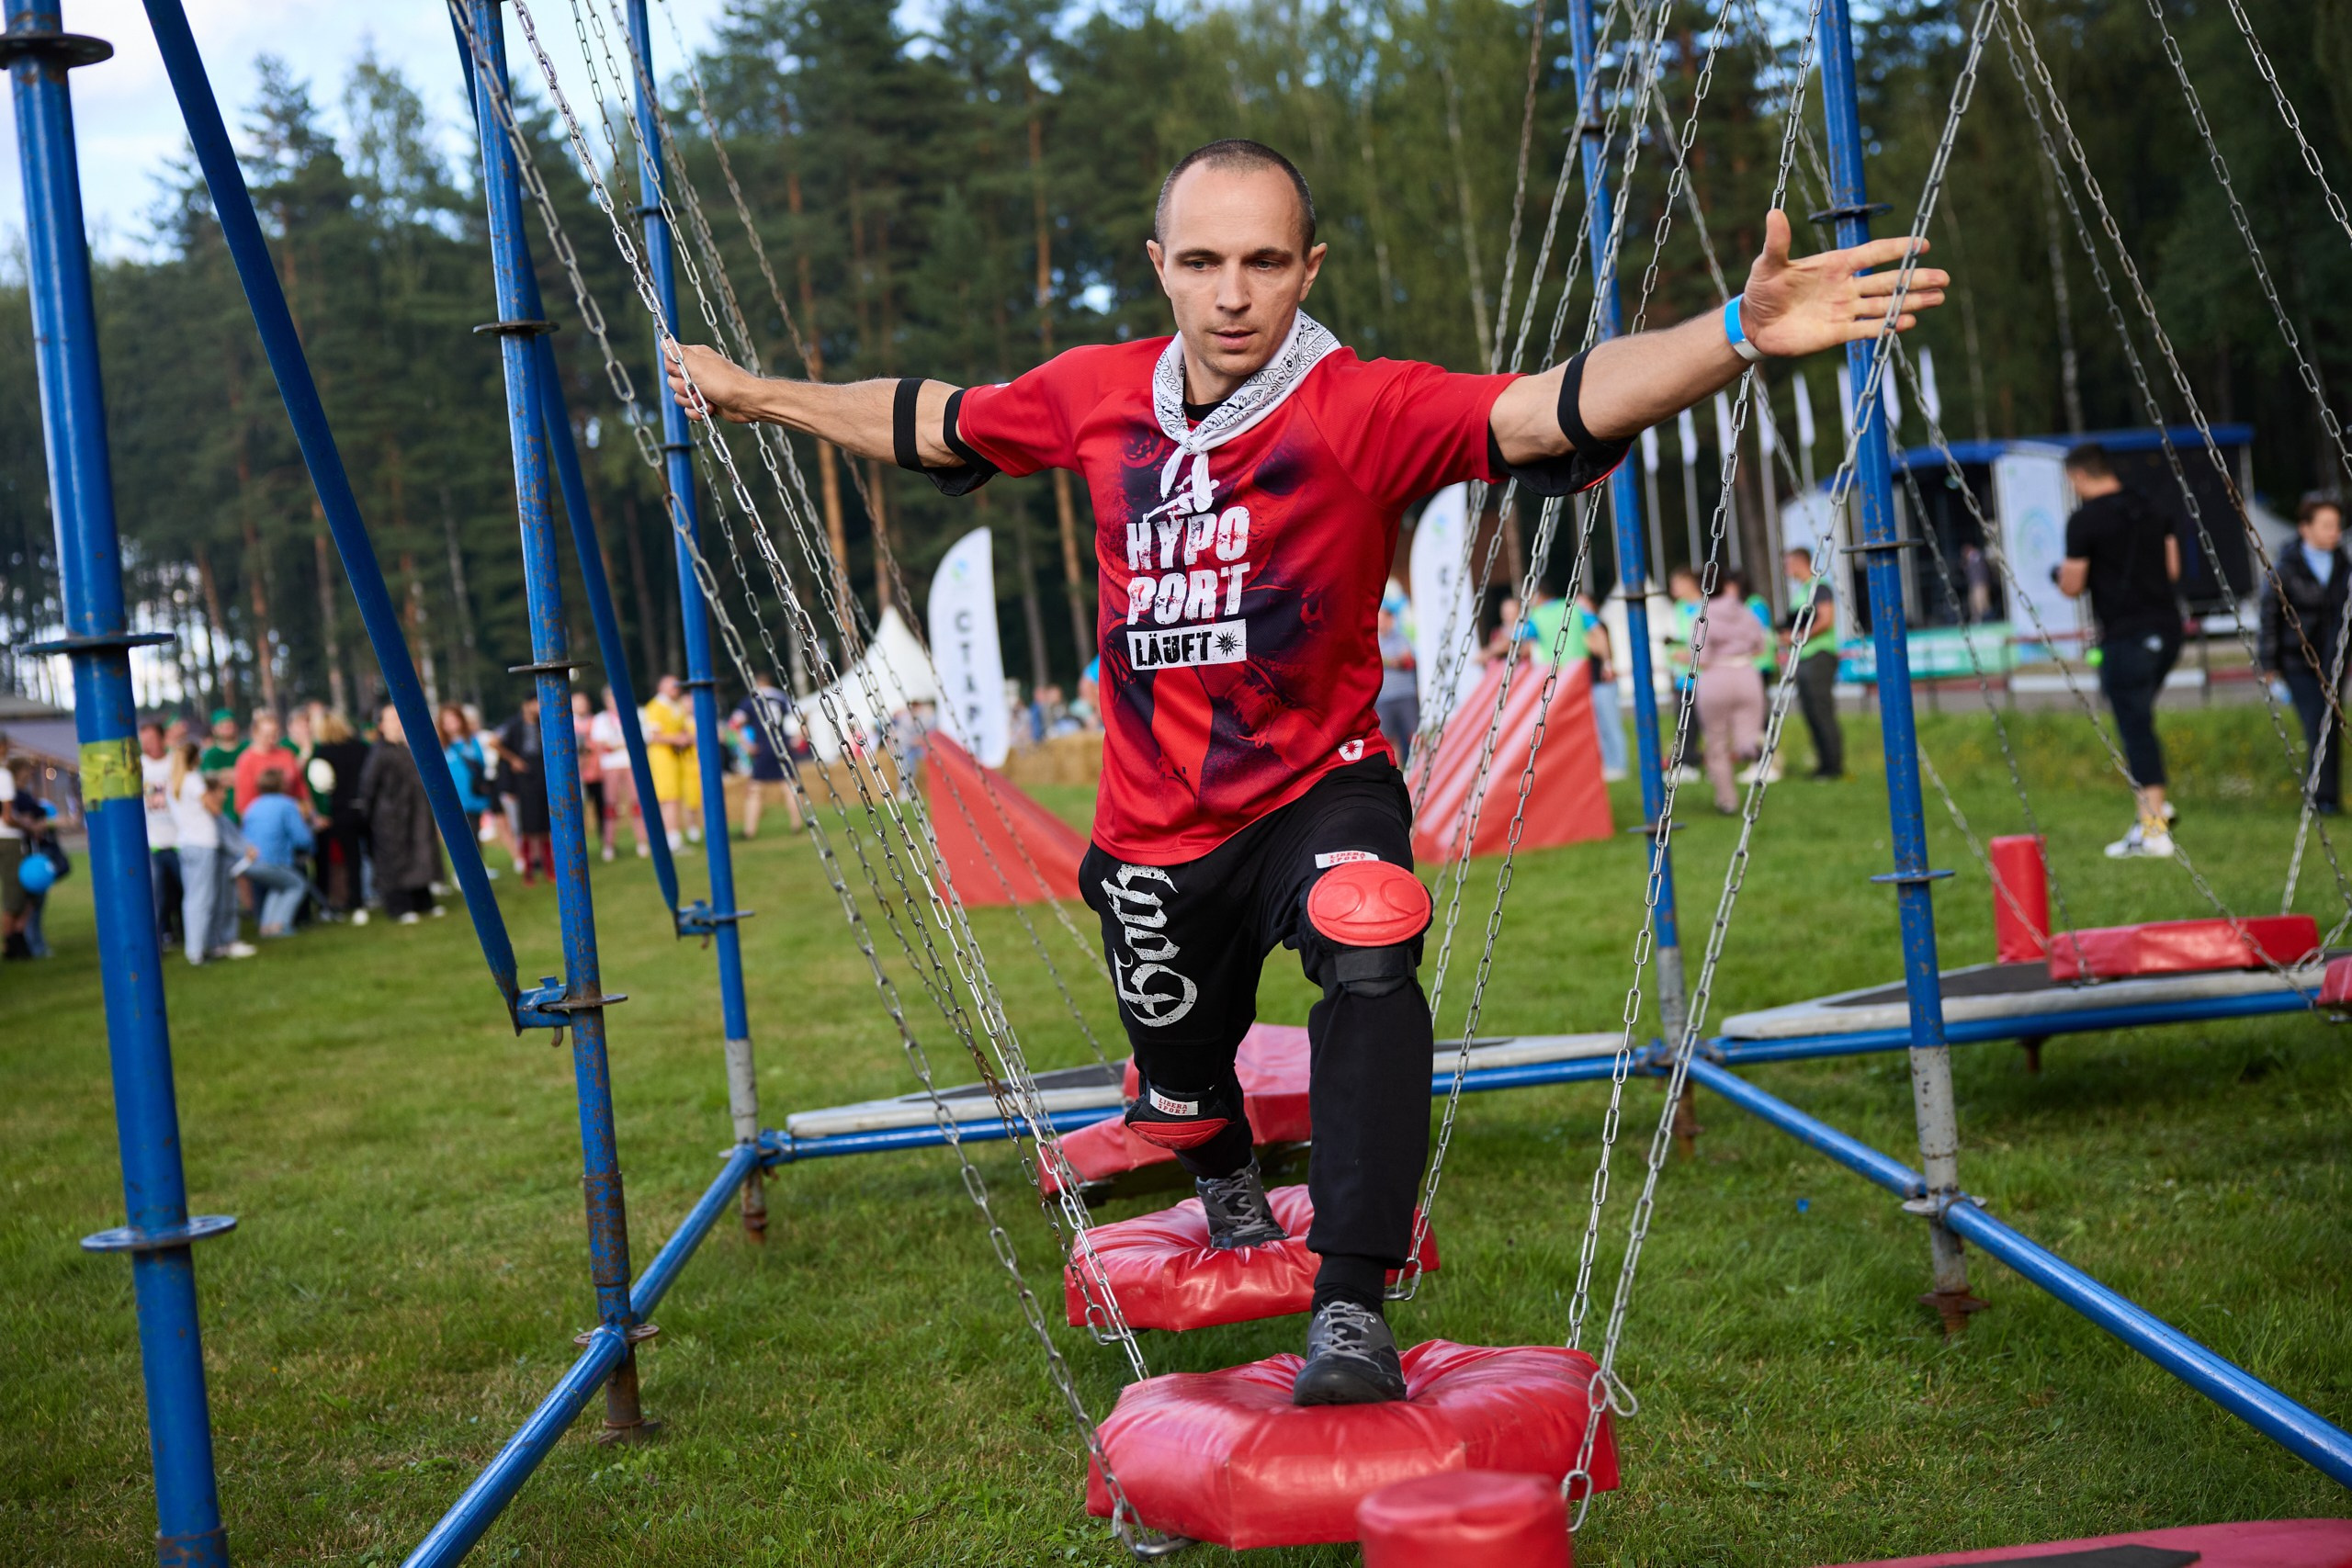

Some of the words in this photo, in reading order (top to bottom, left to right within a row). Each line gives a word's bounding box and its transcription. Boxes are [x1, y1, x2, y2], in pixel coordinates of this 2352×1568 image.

[1126, 506, 1250, 570] HYPO
[1126, 562, 1250, 626] PORT
[1135, 631, 1213, 667] LÄUFT
[1159, 1098, 1187, 1109] LIBERA
[1159, 1103, 1187, 1114] SPORT
